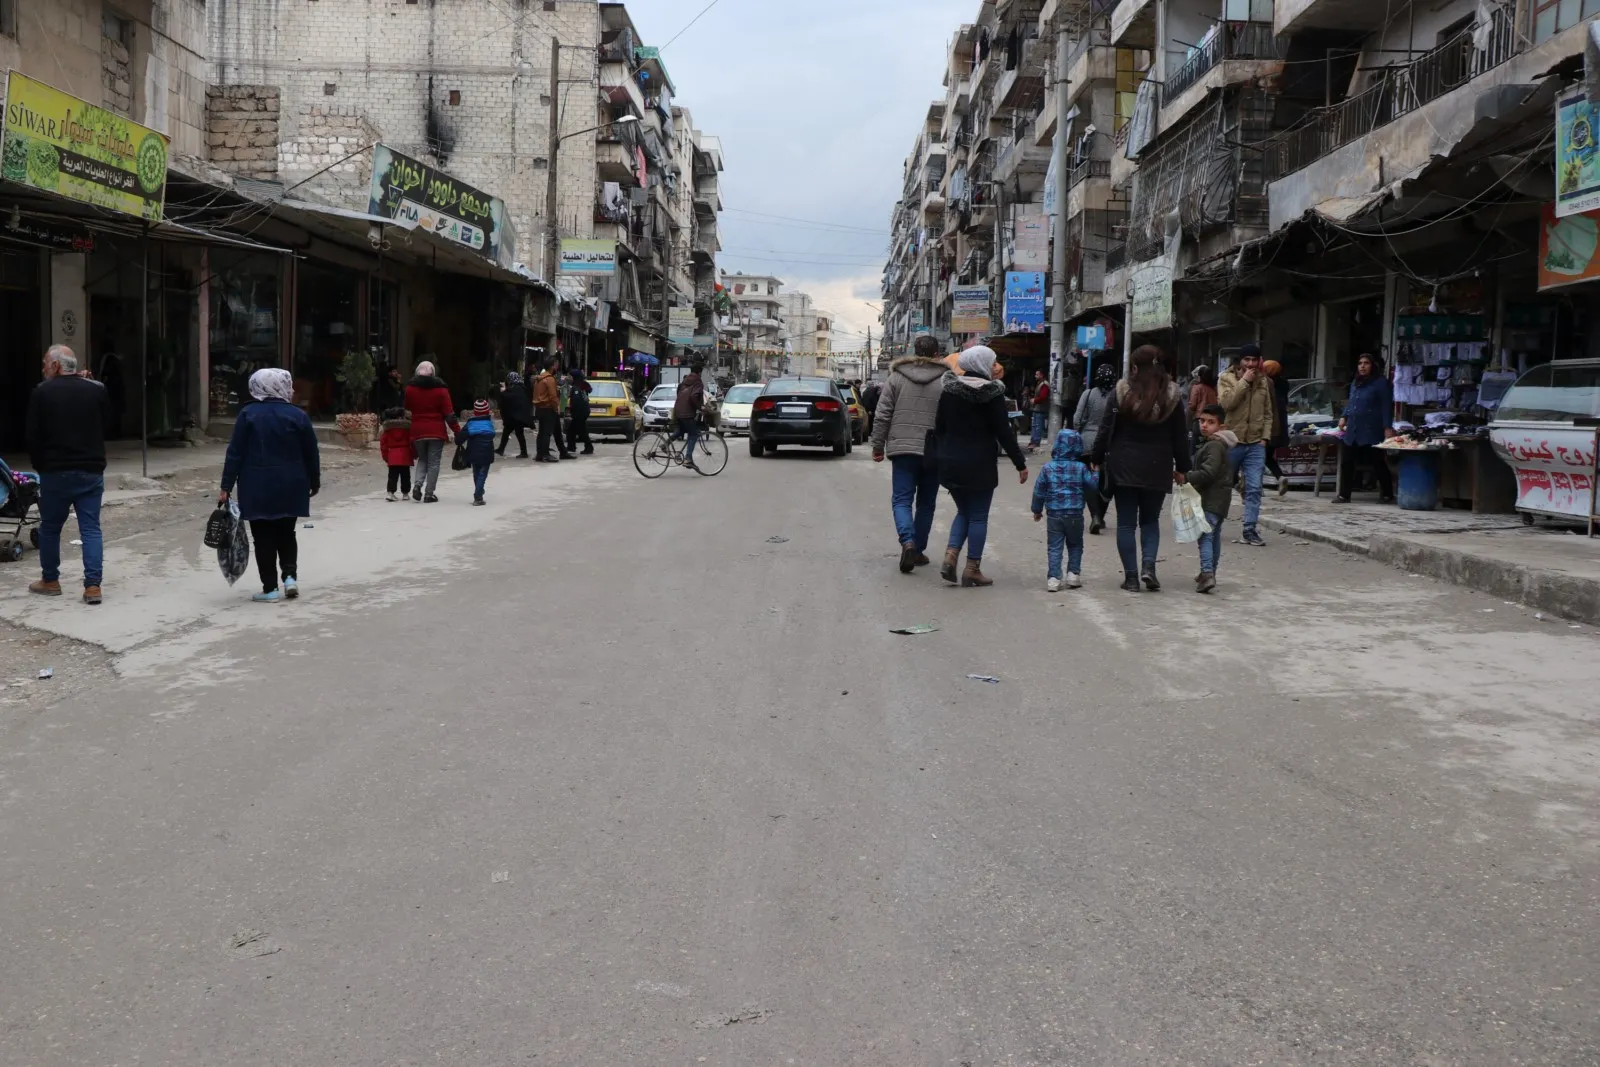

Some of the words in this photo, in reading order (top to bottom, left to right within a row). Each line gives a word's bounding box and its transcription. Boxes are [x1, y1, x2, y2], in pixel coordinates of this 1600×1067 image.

[58, 108, 94, 145] سيوار
[96, 126, 135, 161] حلويات
[390, 159, 426, 191] اخوان
[428, 177, 457, 206] داوود
[459, 191, 489, 220] مجمع
[400, 207, 419, 223] FILA
[562, 251, 585, 262] الطبية
[586, 252, 614, 263] للتحاليل
